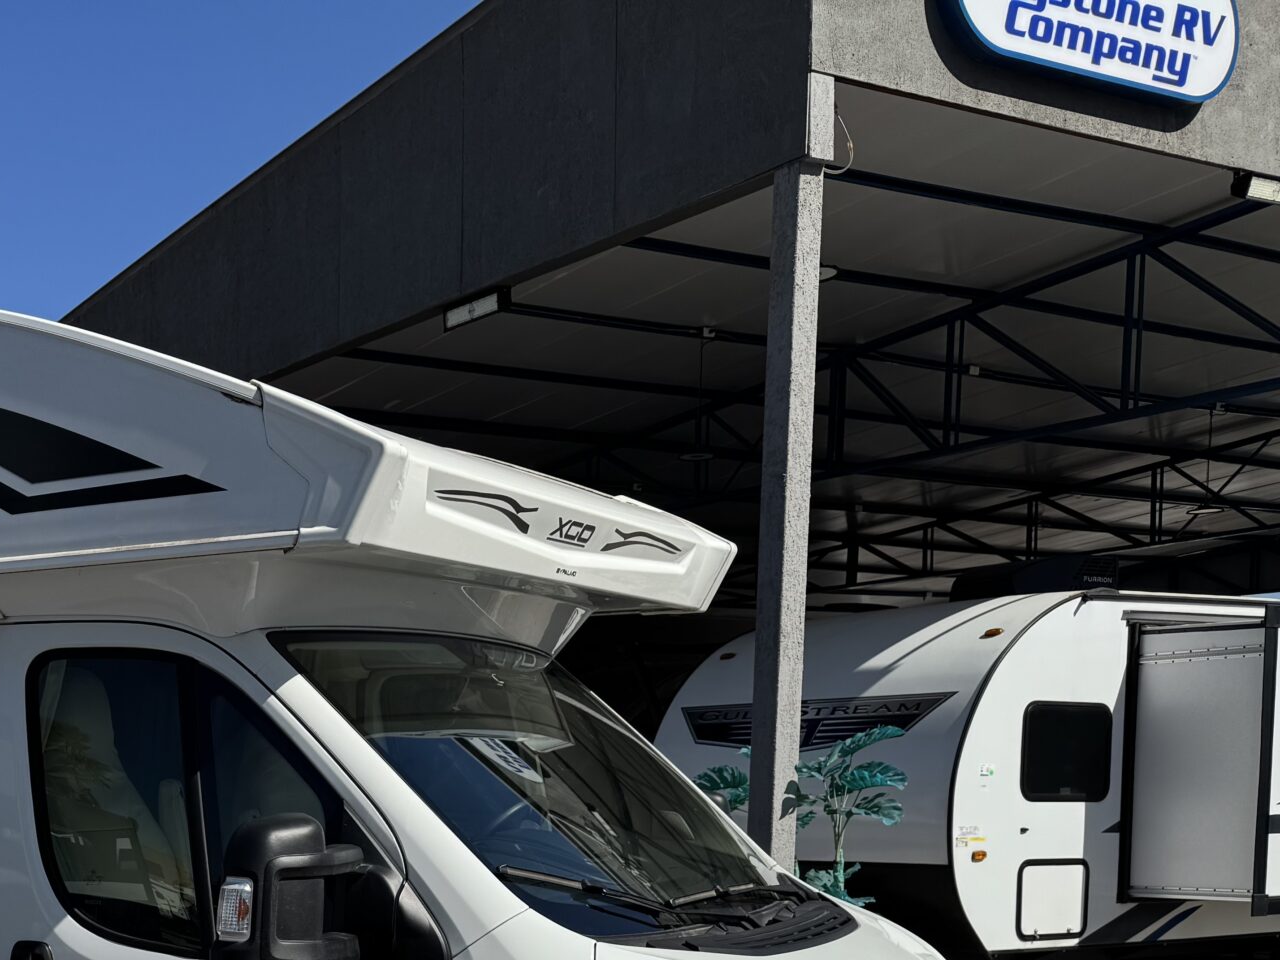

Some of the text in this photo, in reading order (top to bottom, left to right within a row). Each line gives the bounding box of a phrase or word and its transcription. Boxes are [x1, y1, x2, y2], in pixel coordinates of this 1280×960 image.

[1171, 3, 1227, 47] RV
[1004, 0, 1192, 88] Company
[548, 516, 596, 544] XGO
[1083, 575, 1113, 583] FURRION
[698, 709, 753, 723] GUL
